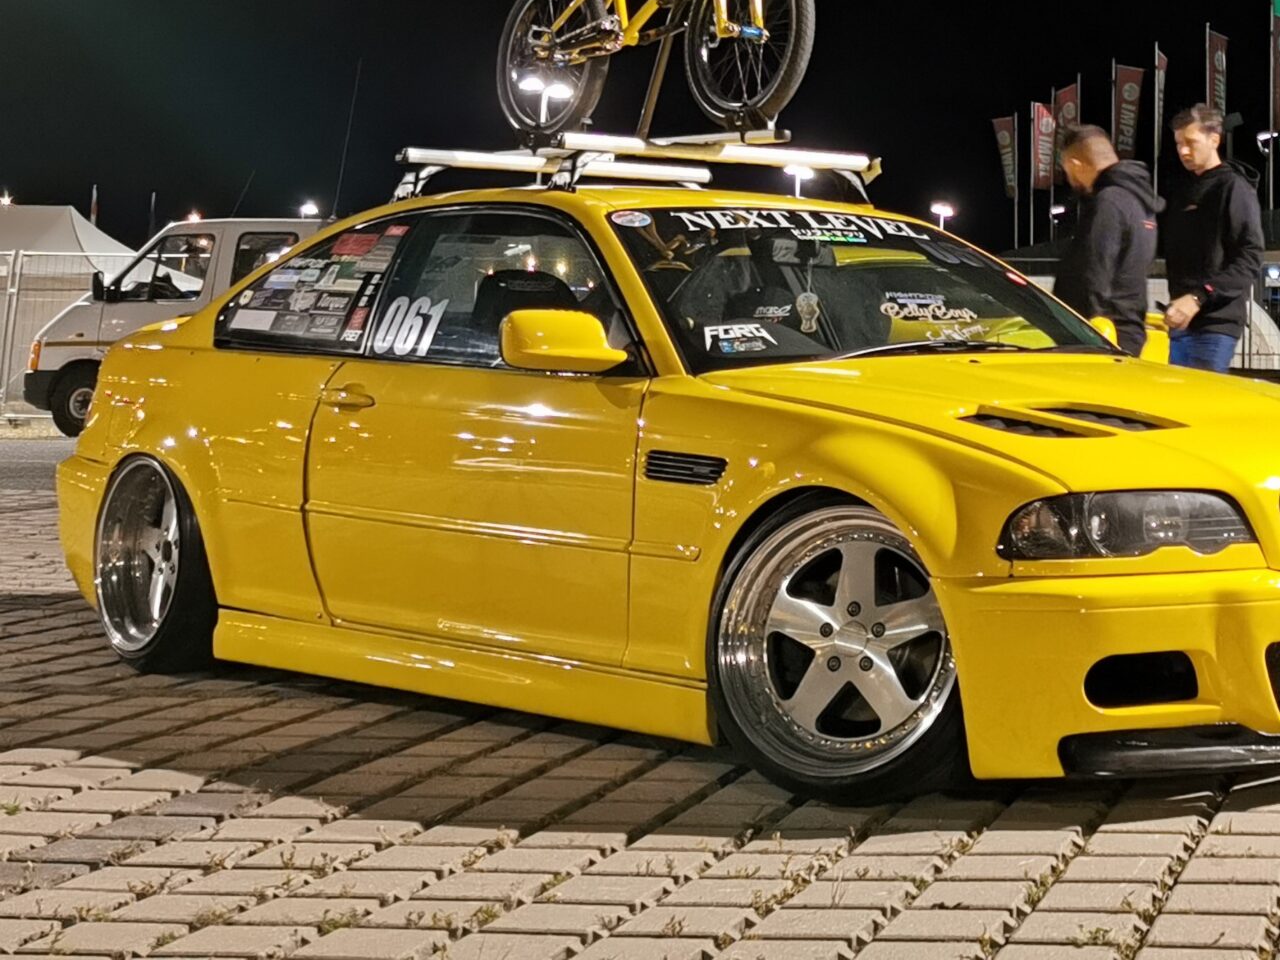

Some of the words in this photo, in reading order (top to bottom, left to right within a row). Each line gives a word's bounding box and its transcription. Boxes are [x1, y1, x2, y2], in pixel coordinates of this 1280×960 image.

[1117, 102, 1137, 151] IMPEL
[670, 210, 797, 231] NEXT
[796, 211, 931, 240] LEVEL
[373, 295, 450, 357] 061
[880, 302, 932, 323] Belly
